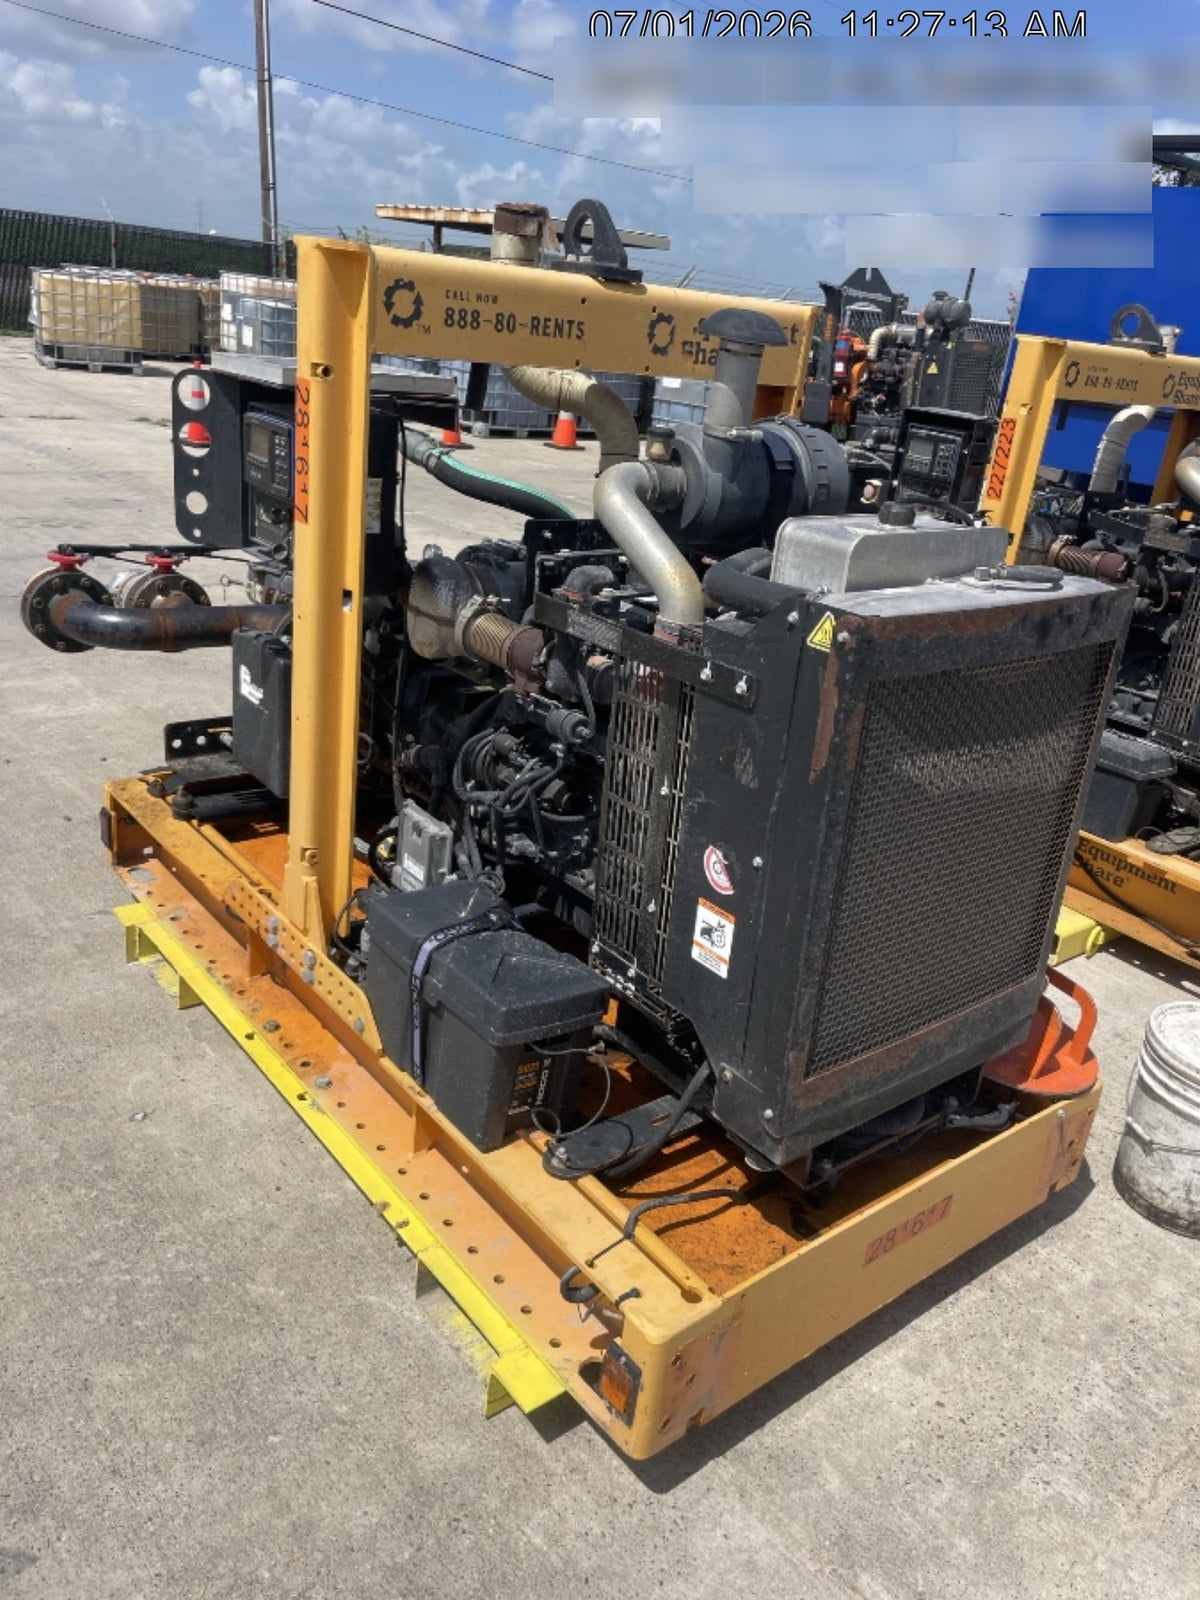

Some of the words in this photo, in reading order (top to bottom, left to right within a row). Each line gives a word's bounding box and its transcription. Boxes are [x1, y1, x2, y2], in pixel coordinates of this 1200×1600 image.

[443, 306, 586, 341] 888-80-RENTS
[986, 419, 1016, 499] 227223
[1080, 838, 1178, 895] Equipment
